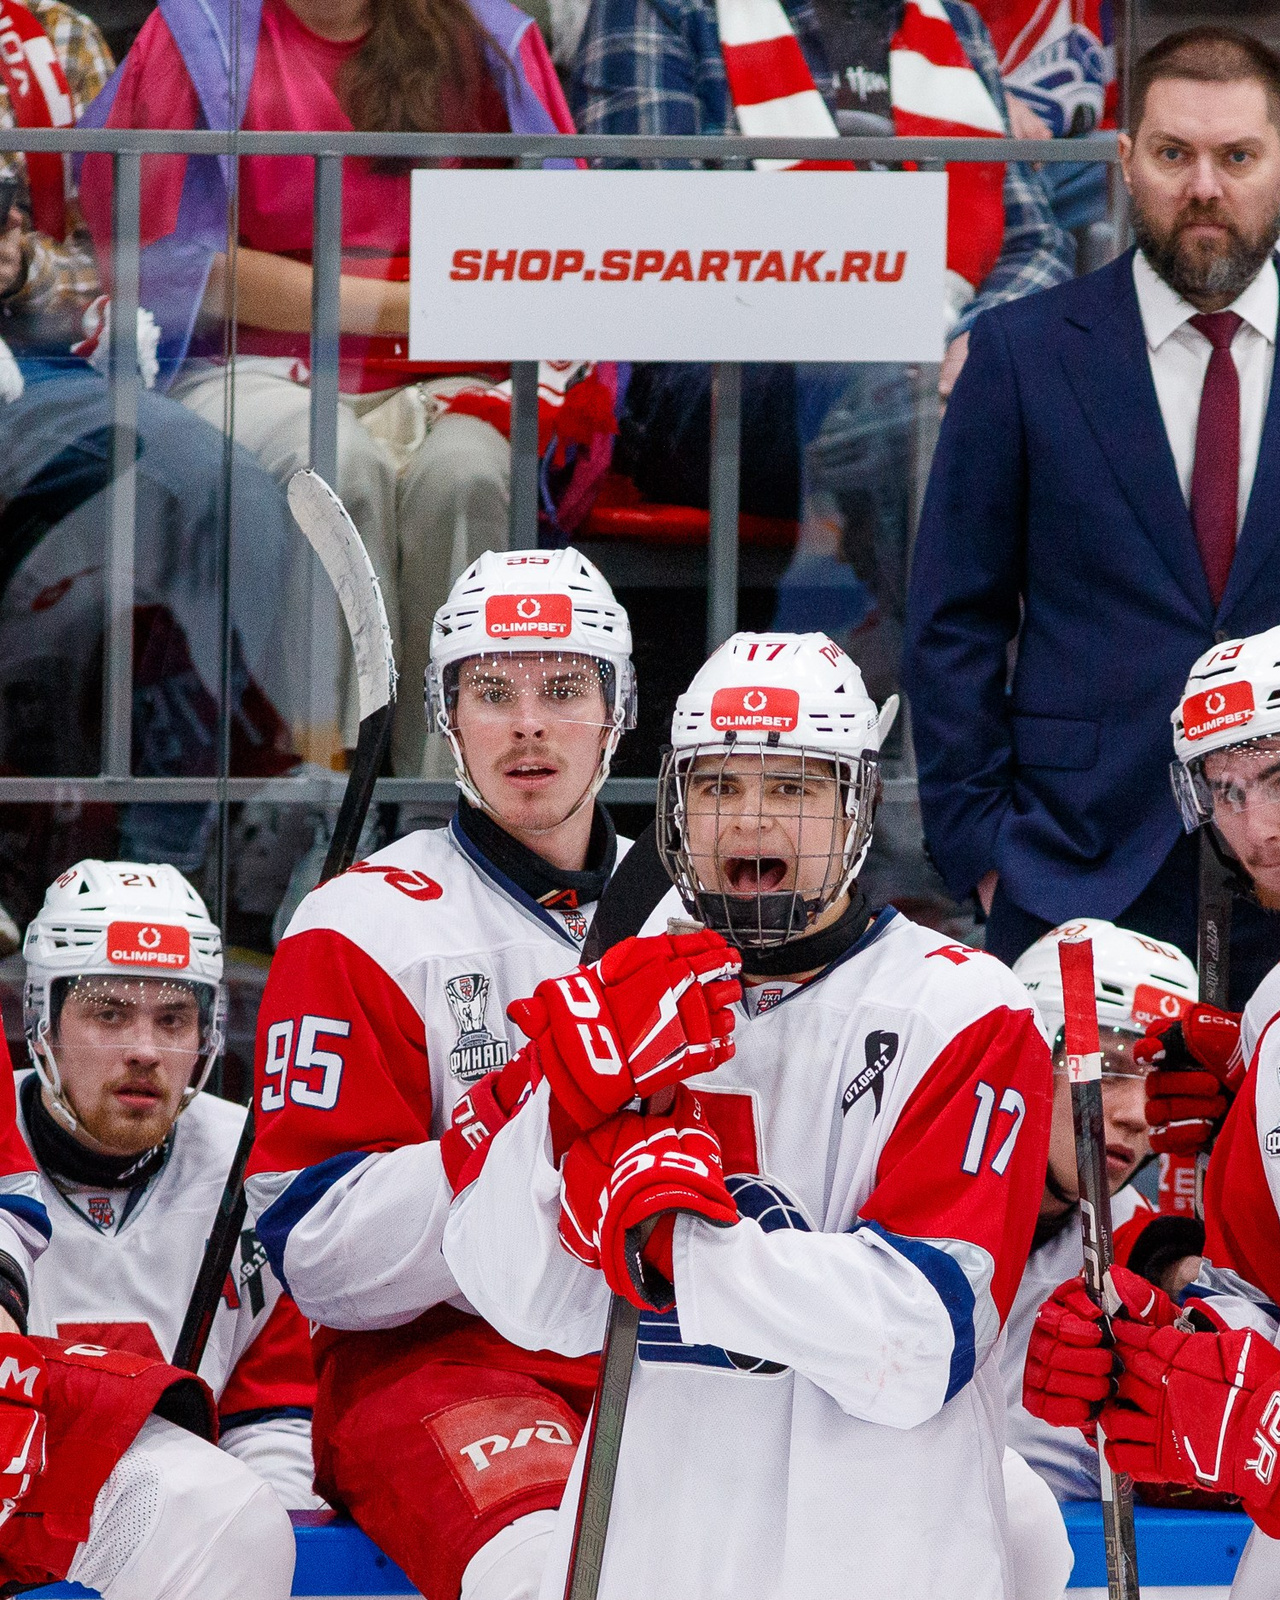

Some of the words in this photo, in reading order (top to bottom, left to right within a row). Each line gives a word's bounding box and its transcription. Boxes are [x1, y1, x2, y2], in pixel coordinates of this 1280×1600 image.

[449, 249, 908, 283] SHOP.SPARTAK.RU
[490, 622, 568, 635] OLIMPBET
[747, 643, 787, 661] 17
[715, 714, 793, 727] OLIMPBET
[1188, 710, 1254, 738] OLIMPBET
[119, 873, 157, 889] 21
[112, 950, 185, 965] OLIMPBET
[261, 1014, 351, 1113] 95
[450, 1042, 508, 1077] ФИНАЛ
[844, 1054, 890, 1103] 07.09.11
[961, 1079, 1026, 1176] 17
